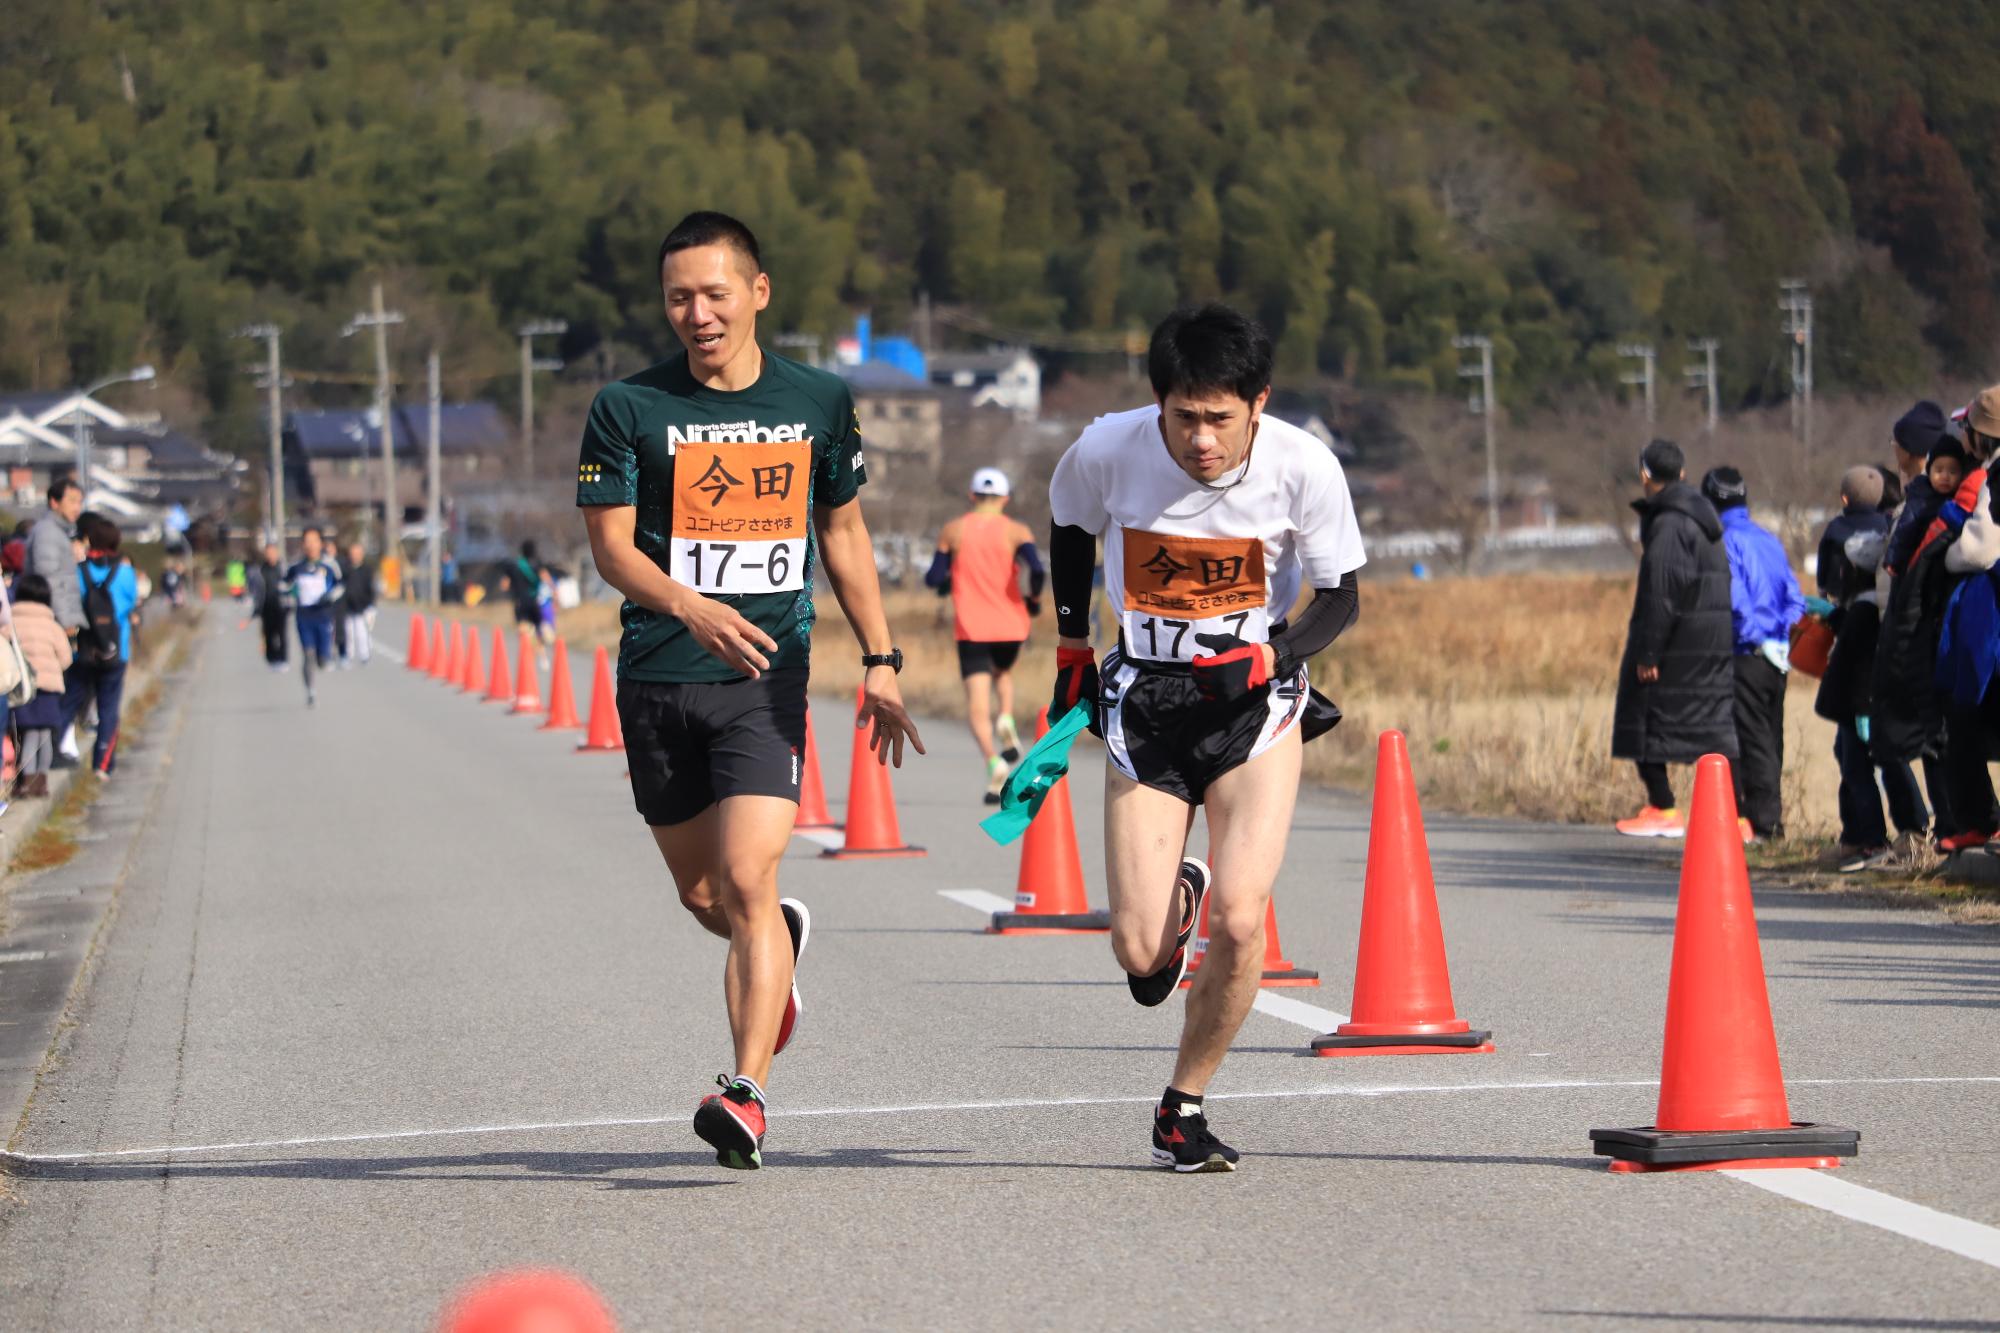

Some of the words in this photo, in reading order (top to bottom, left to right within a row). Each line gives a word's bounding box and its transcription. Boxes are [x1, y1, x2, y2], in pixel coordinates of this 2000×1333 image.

[667, 420, 807, 456] Number
[694, 423, 719, 432] Sports
[720, 421, 748, 431] Graphic
[688, 453, 795, 507] 今田
[687, 542, 790, 588] 17-6
[1139, 544, 1246, 586] 今田
[1141, 610, 1250, 659] 177
